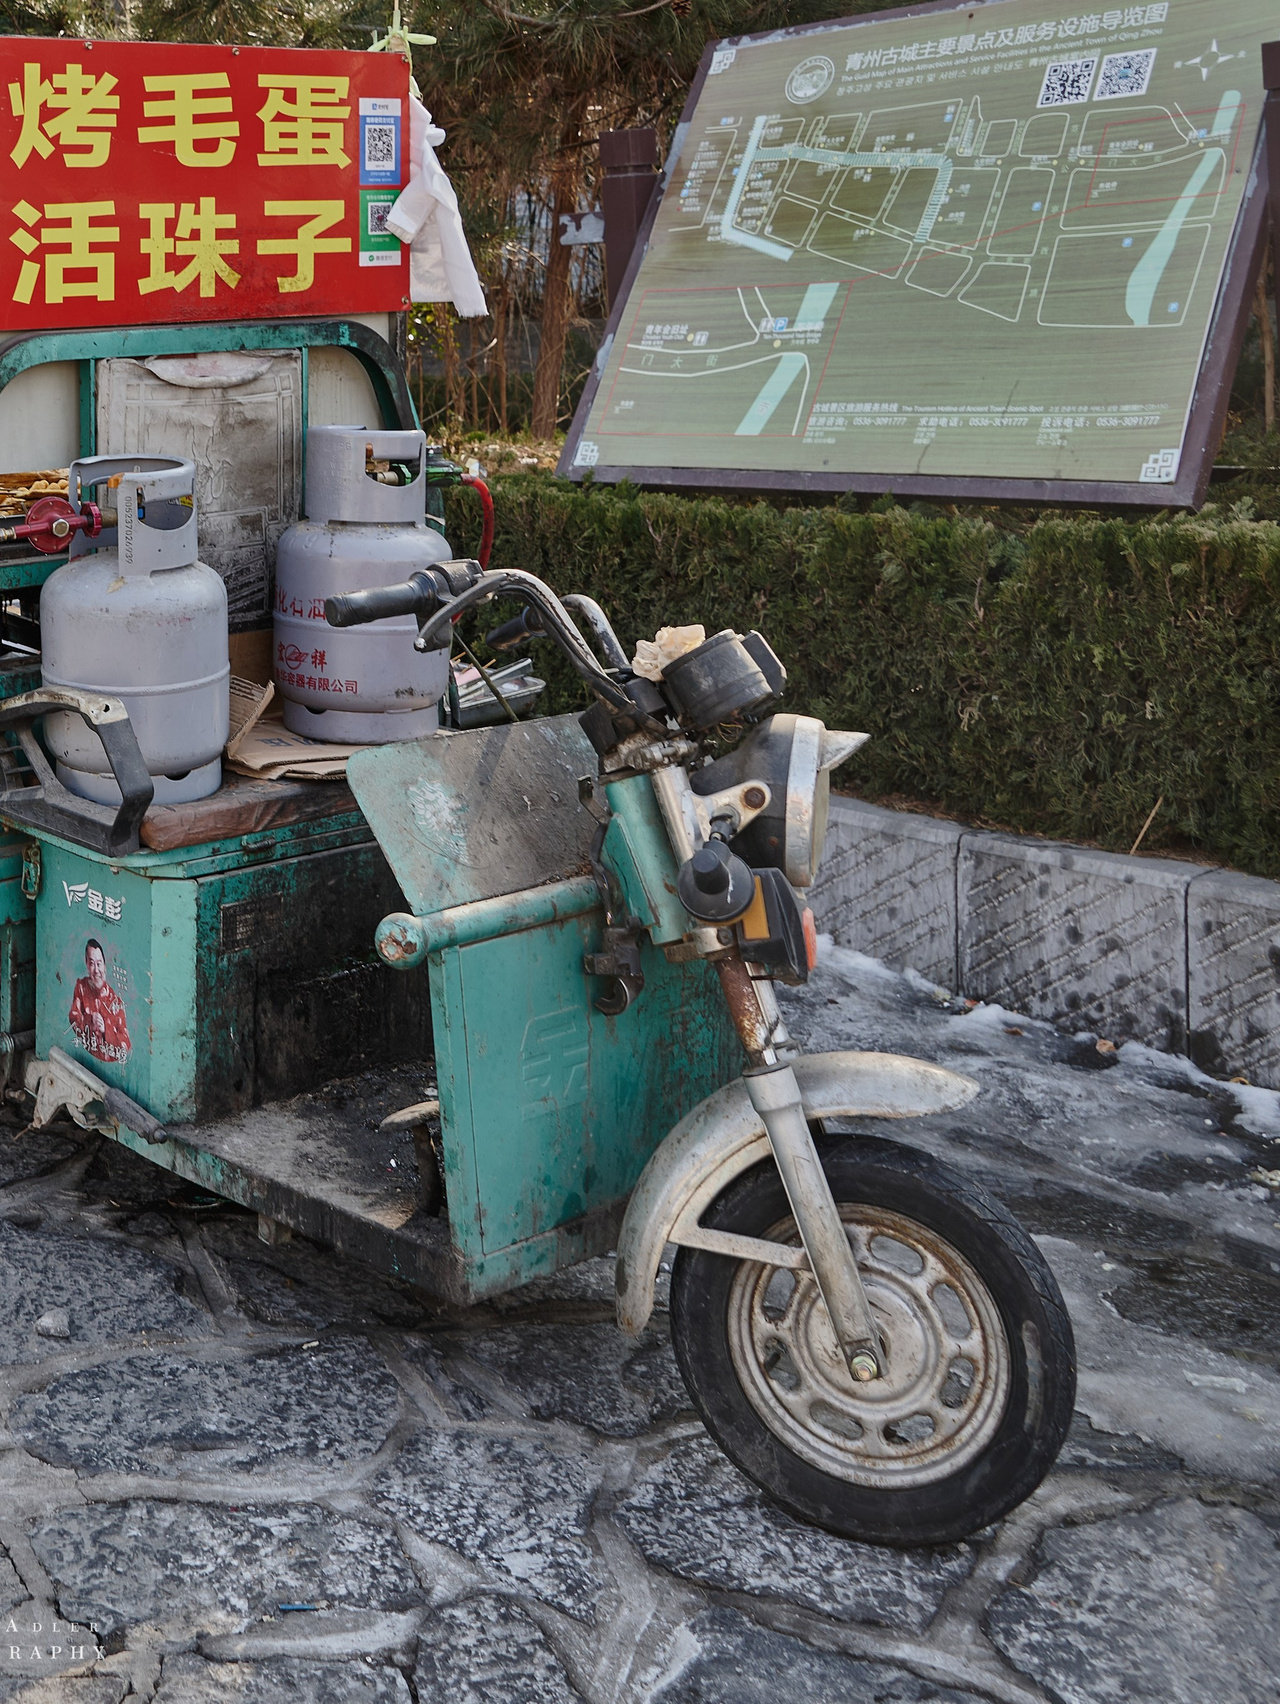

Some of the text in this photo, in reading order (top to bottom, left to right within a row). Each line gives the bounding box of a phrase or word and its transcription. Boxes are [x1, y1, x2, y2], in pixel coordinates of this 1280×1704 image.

[845, 1, 1170, 72] 青州古城主要景点及服务设施导览图
[1085, 37, 1107, 46] Town
[1119, 32, 1139, 41] Qing
[1141, 28, 1163, 37] Zhou
[7, 62, 352, 169] 烤毛蛋
[8, 196, 352, 304] 活珠子
[311, 648, 327, 673] 祥
